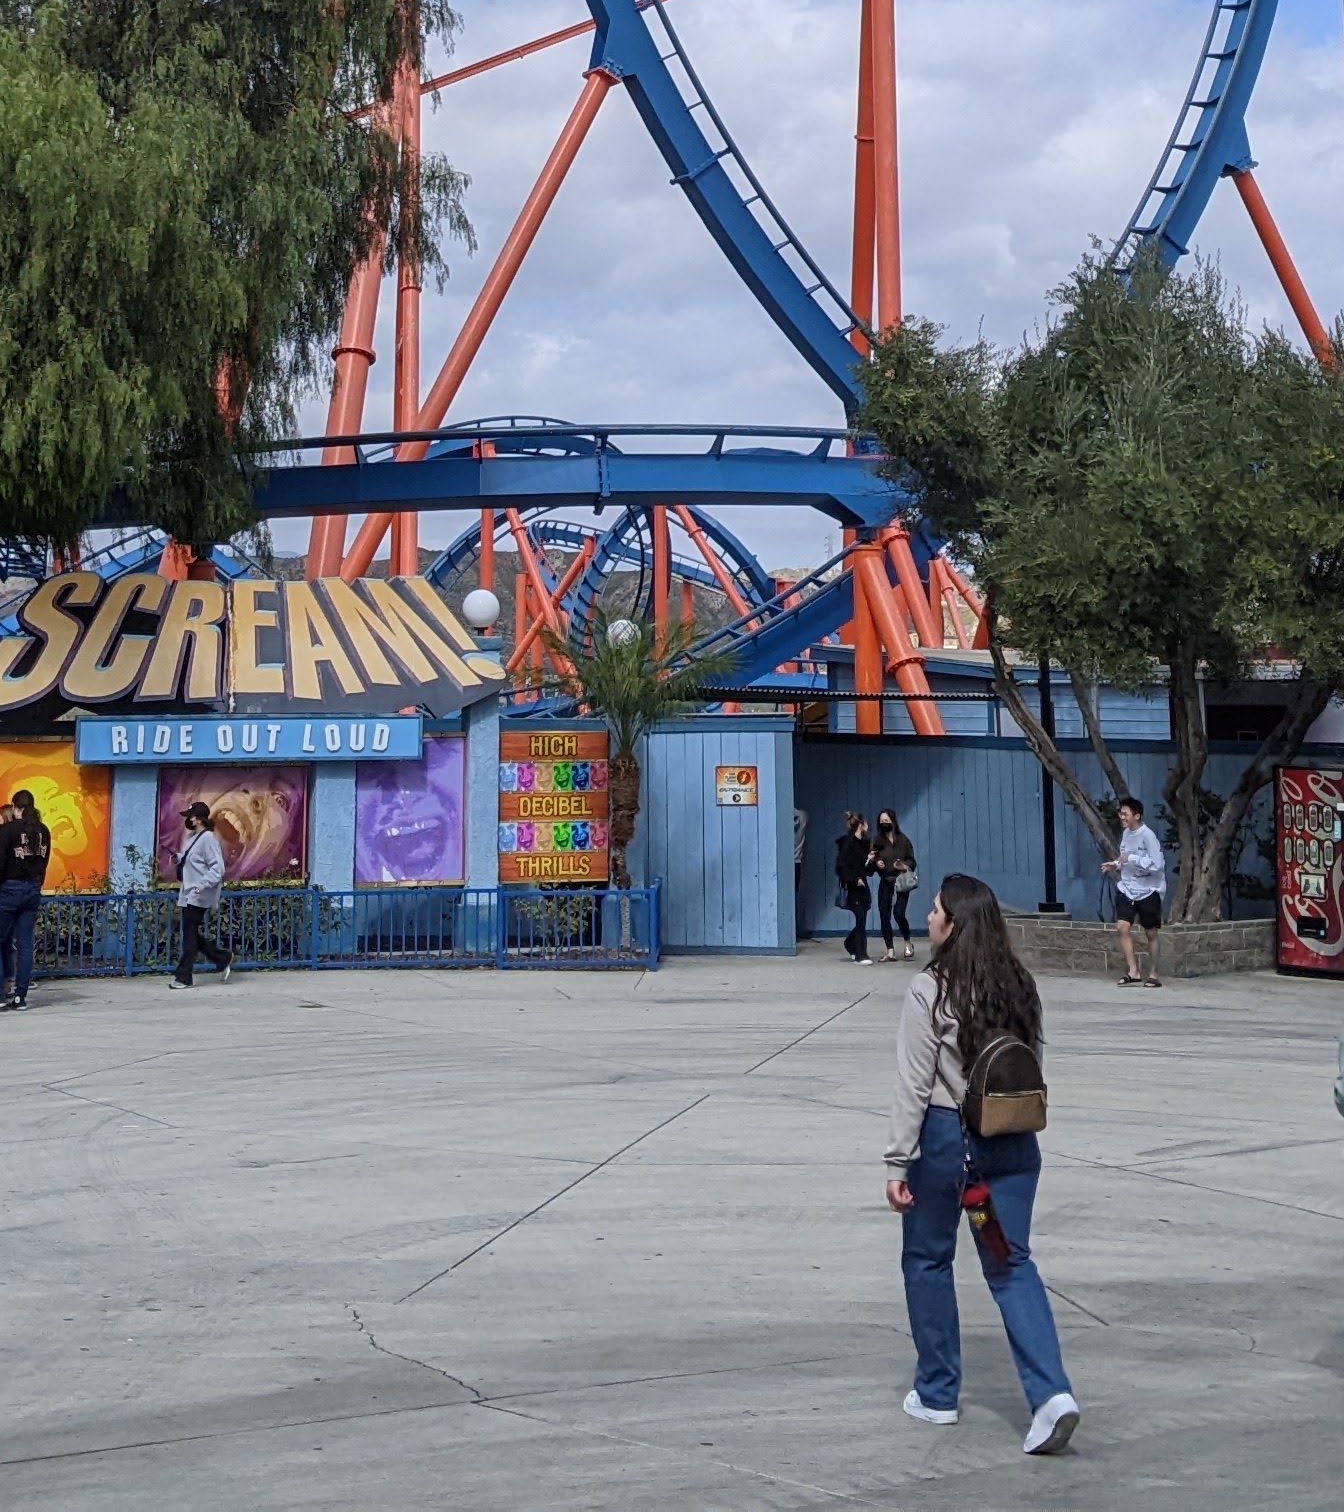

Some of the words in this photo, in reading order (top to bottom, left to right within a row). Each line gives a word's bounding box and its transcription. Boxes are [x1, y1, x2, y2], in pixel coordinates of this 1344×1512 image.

[111, 724, 193, 754] RIDE
[217, 724, 281, 753] OUT
[302, 723, 390, 753] LOUD
[530, 735, 577, 757] HIGH
[518, 796, 593, 817] DECIBEL
[516, 855, 591, 878] THRILLS
